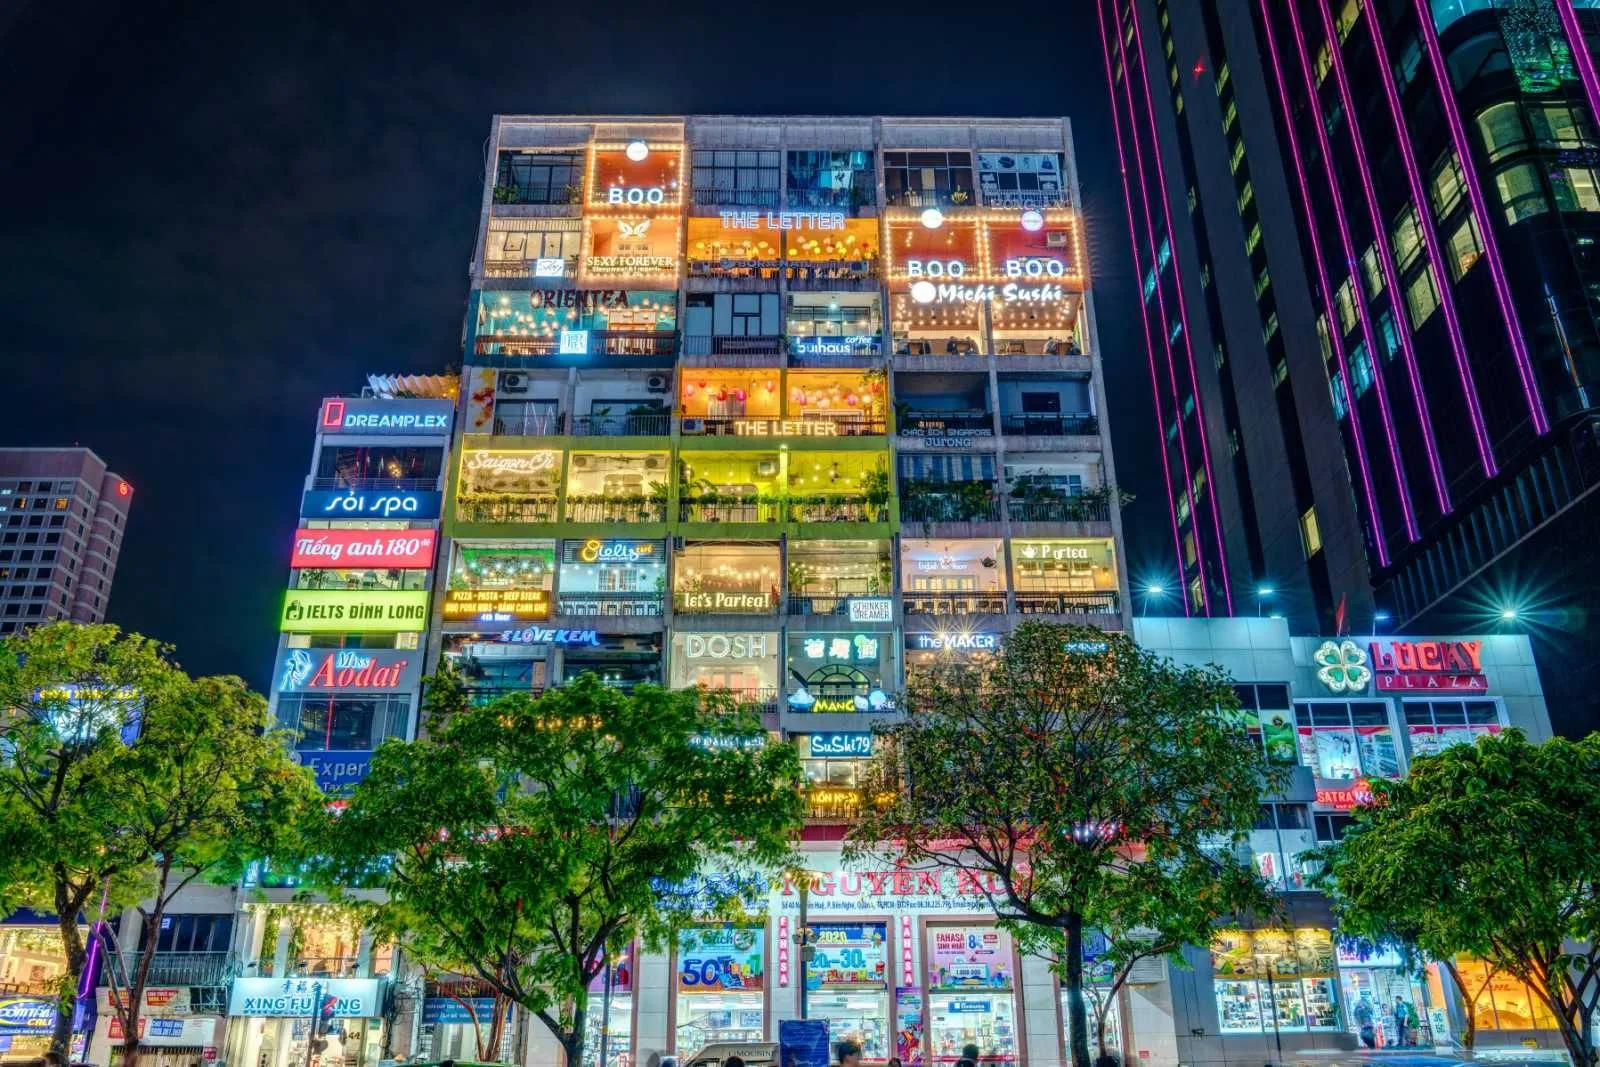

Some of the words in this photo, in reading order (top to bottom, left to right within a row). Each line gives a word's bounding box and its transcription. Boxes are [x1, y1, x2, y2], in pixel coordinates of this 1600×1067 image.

[608, 187, 664, 205] BOO
[720, 211, 759, 229] THE
[767, 212, 846, 230] LETTER
[586, 256, 617, 266] SEXY
[619, 256, 674, 266] FOREVER
[907, 260, 964, 278] BOO
[1006, 259, 1064, 277] BOO
[530, 288, 629, 308] ORIENTEA
[937, 283, 995, 304] Michi
[1002, 282, 1063, 302] Sushi
[344, 414, 448, 428] DREAMPLEX
[735, 420, 768, 436] THE
[773, 420, 838, 436] LETTER
[370, 496, 418, 516] spa
[296, 536, 343, 560] Tiếng
[347, 539, 383, 556] anh
[386, 538, 420, 556] 180
[454, 592, 473, 601] PIZZA
[478, 592, 498, 601] PASTA
[306, 605, 345, 619] IELTS
[388, 605, 425, 619] LONG
[512, 626, 556, 643] LOVE
[555, 629, 600, 646] KEM
[944, 635, 994, 648] MAKER
[686, 635, 766, 658] DOSH
[1369, 640, 1482, 671] LUCKY
[336, 651, 370, 668] Miss
[309, 653, 408, 688] Aodai
[1384, 675, 1480, 687] PLAZA
[780, 916, 788, 986] FAHASA
[903, 916, 911, 984] FAHASA
[244, 998, 285, 1009] XING
[291, 998, 310, 1009] FU
